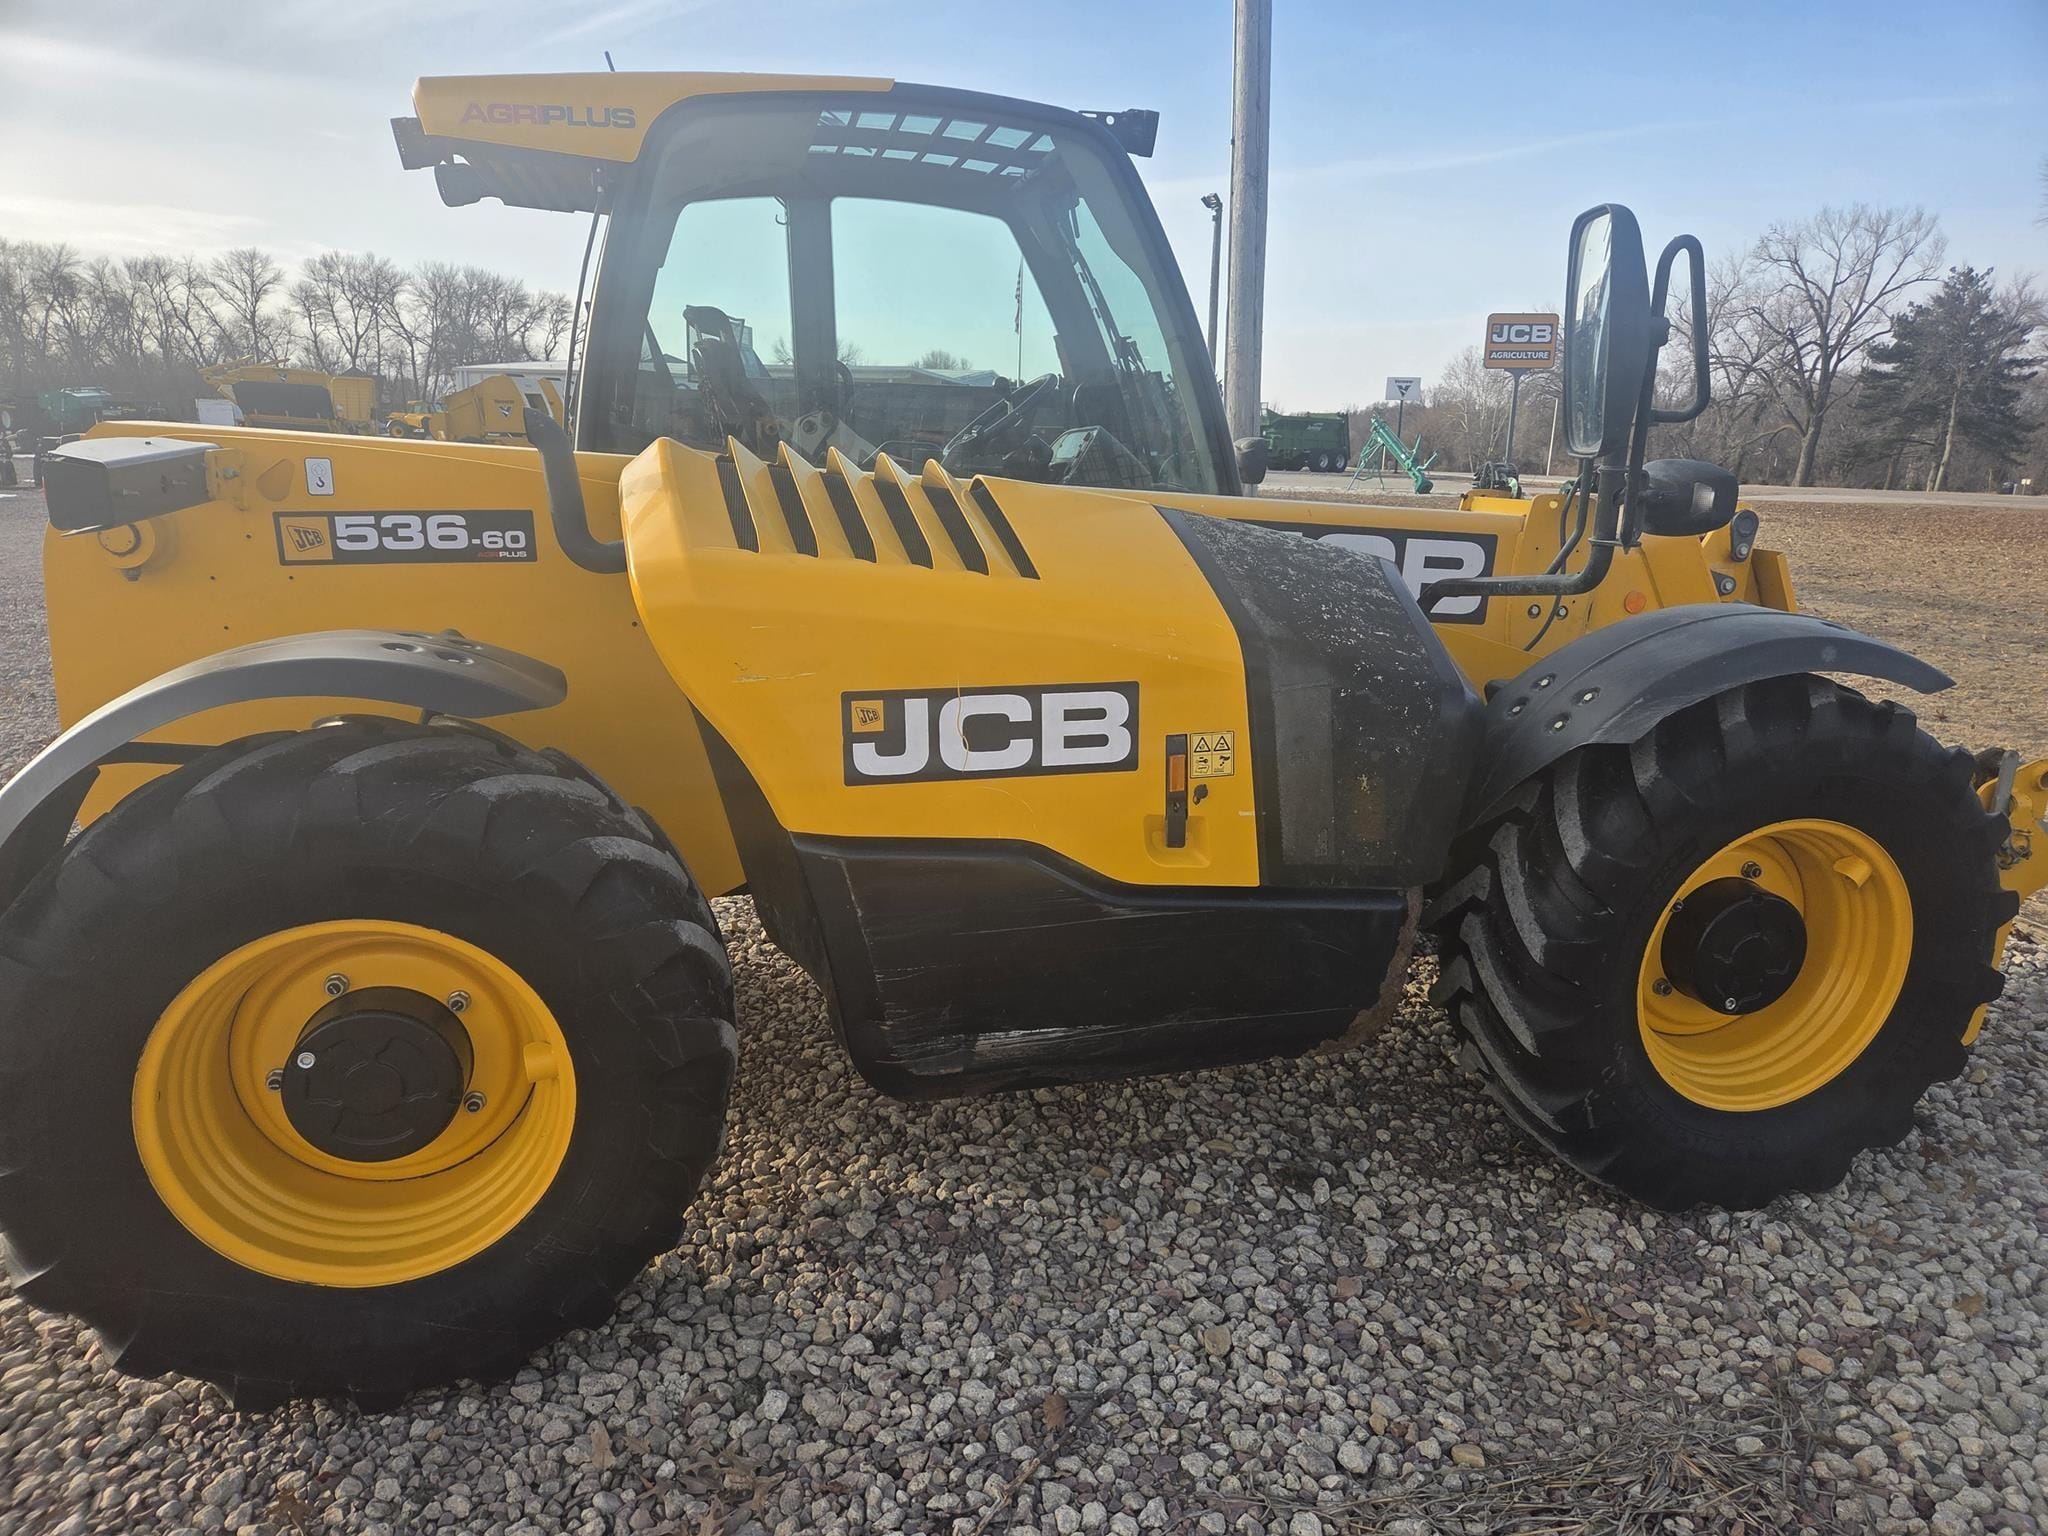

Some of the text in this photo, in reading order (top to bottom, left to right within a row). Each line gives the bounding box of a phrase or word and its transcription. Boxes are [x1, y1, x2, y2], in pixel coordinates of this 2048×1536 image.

[459, 102, 636, 129] AGRIPLUS
[1492, 324, 1552, 343] JCB
[1490, 351, 1550, 360] AGRICULTURE
[293, 528, 323, 549] JCB
[334, 515, 526, 551] 536-60
[859, 709, 879, 723] JCB
[852, 690, 1132, 777] JCB
